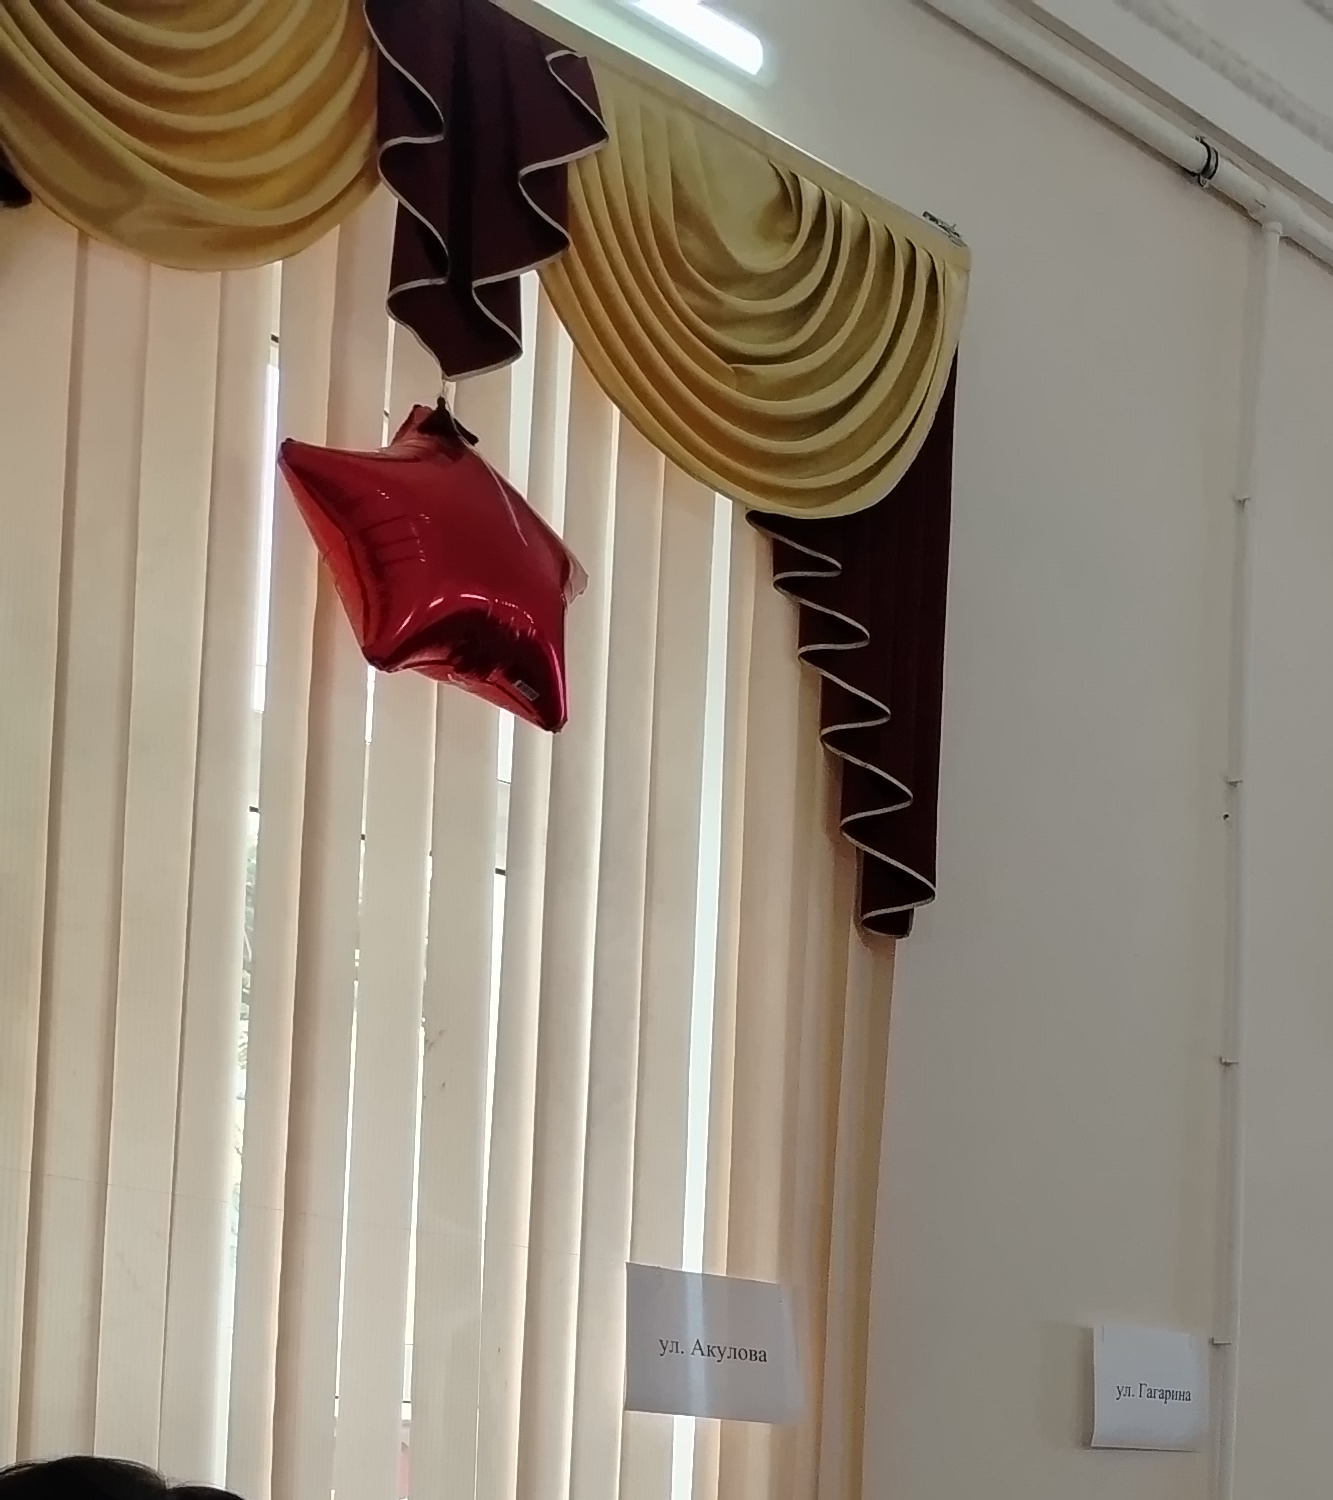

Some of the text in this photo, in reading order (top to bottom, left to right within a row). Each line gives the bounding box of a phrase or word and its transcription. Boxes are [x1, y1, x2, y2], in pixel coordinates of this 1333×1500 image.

[658, 1337, 768, 1364] ул. Акулова
[1115, 1383, 1191, 1404] ул. Гагарина
